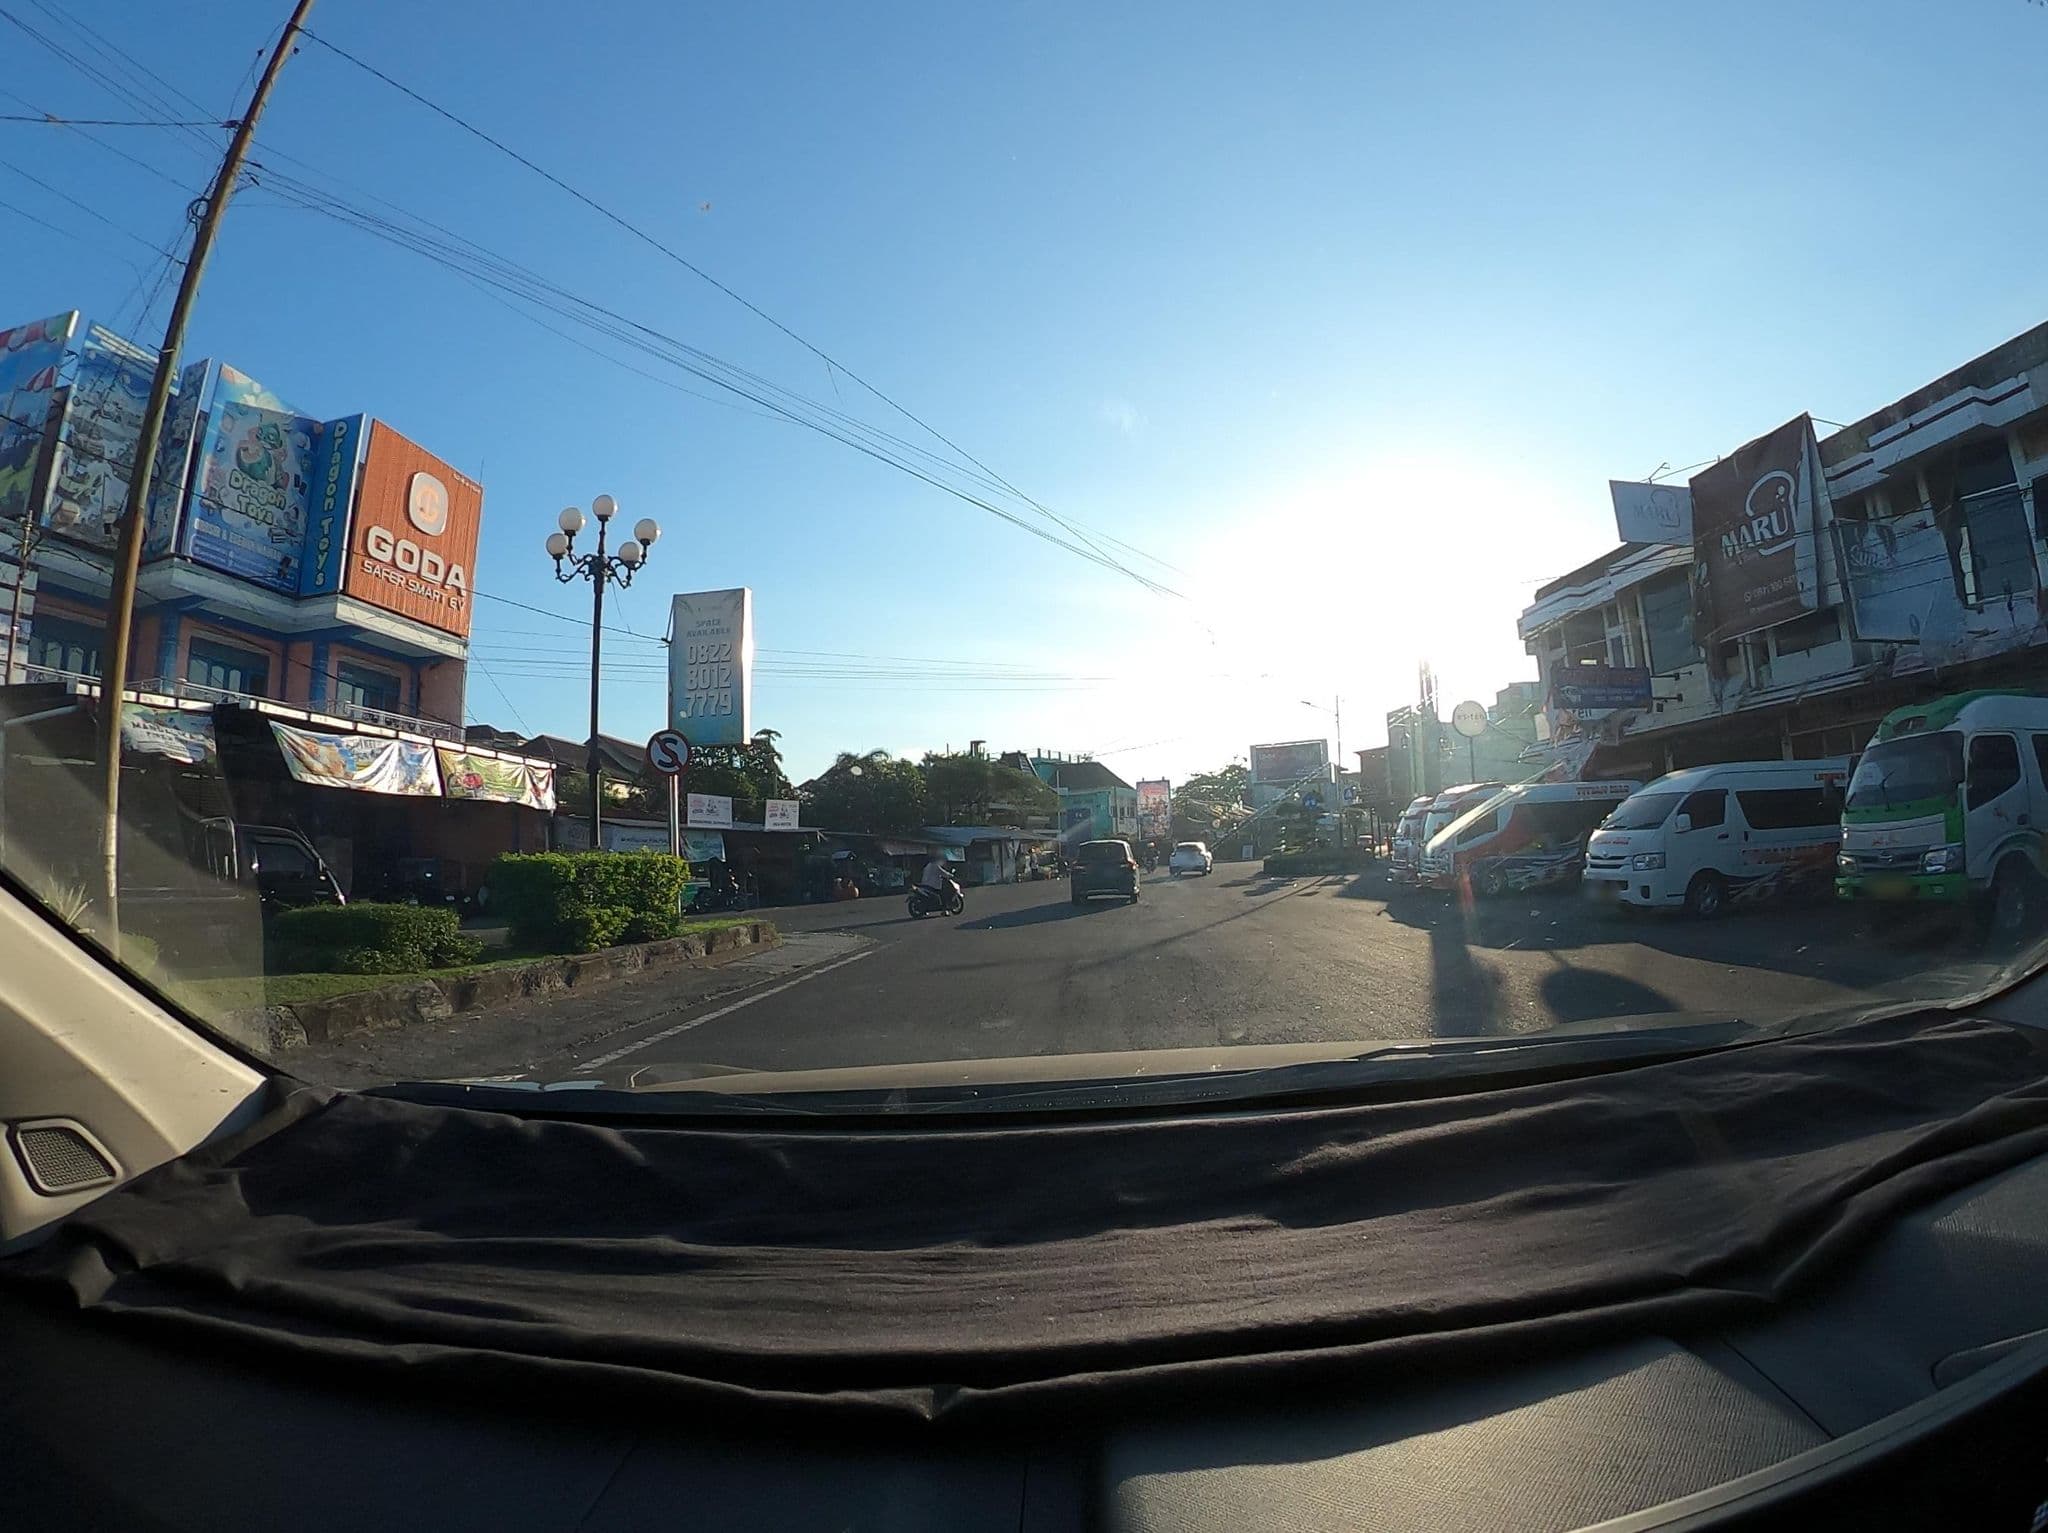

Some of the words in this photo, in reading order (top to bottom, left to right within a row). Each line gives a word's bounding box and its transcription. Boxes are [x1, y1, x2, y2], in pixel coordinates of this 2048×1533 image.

[324, 420, 348, 511] Dragon
[229, 469, 286, 511] Dragon
[1721, 507, 1789, 560] MARU
[363, 560, 407, 588] SAFER
[407, 579, 448, 603] SMART
[367, 525, 467, 597] GODA
[688, 643, 732, 665] 0822
[687, 665, 732, 690] 8012
[686, 691, 733, 718] 7779
